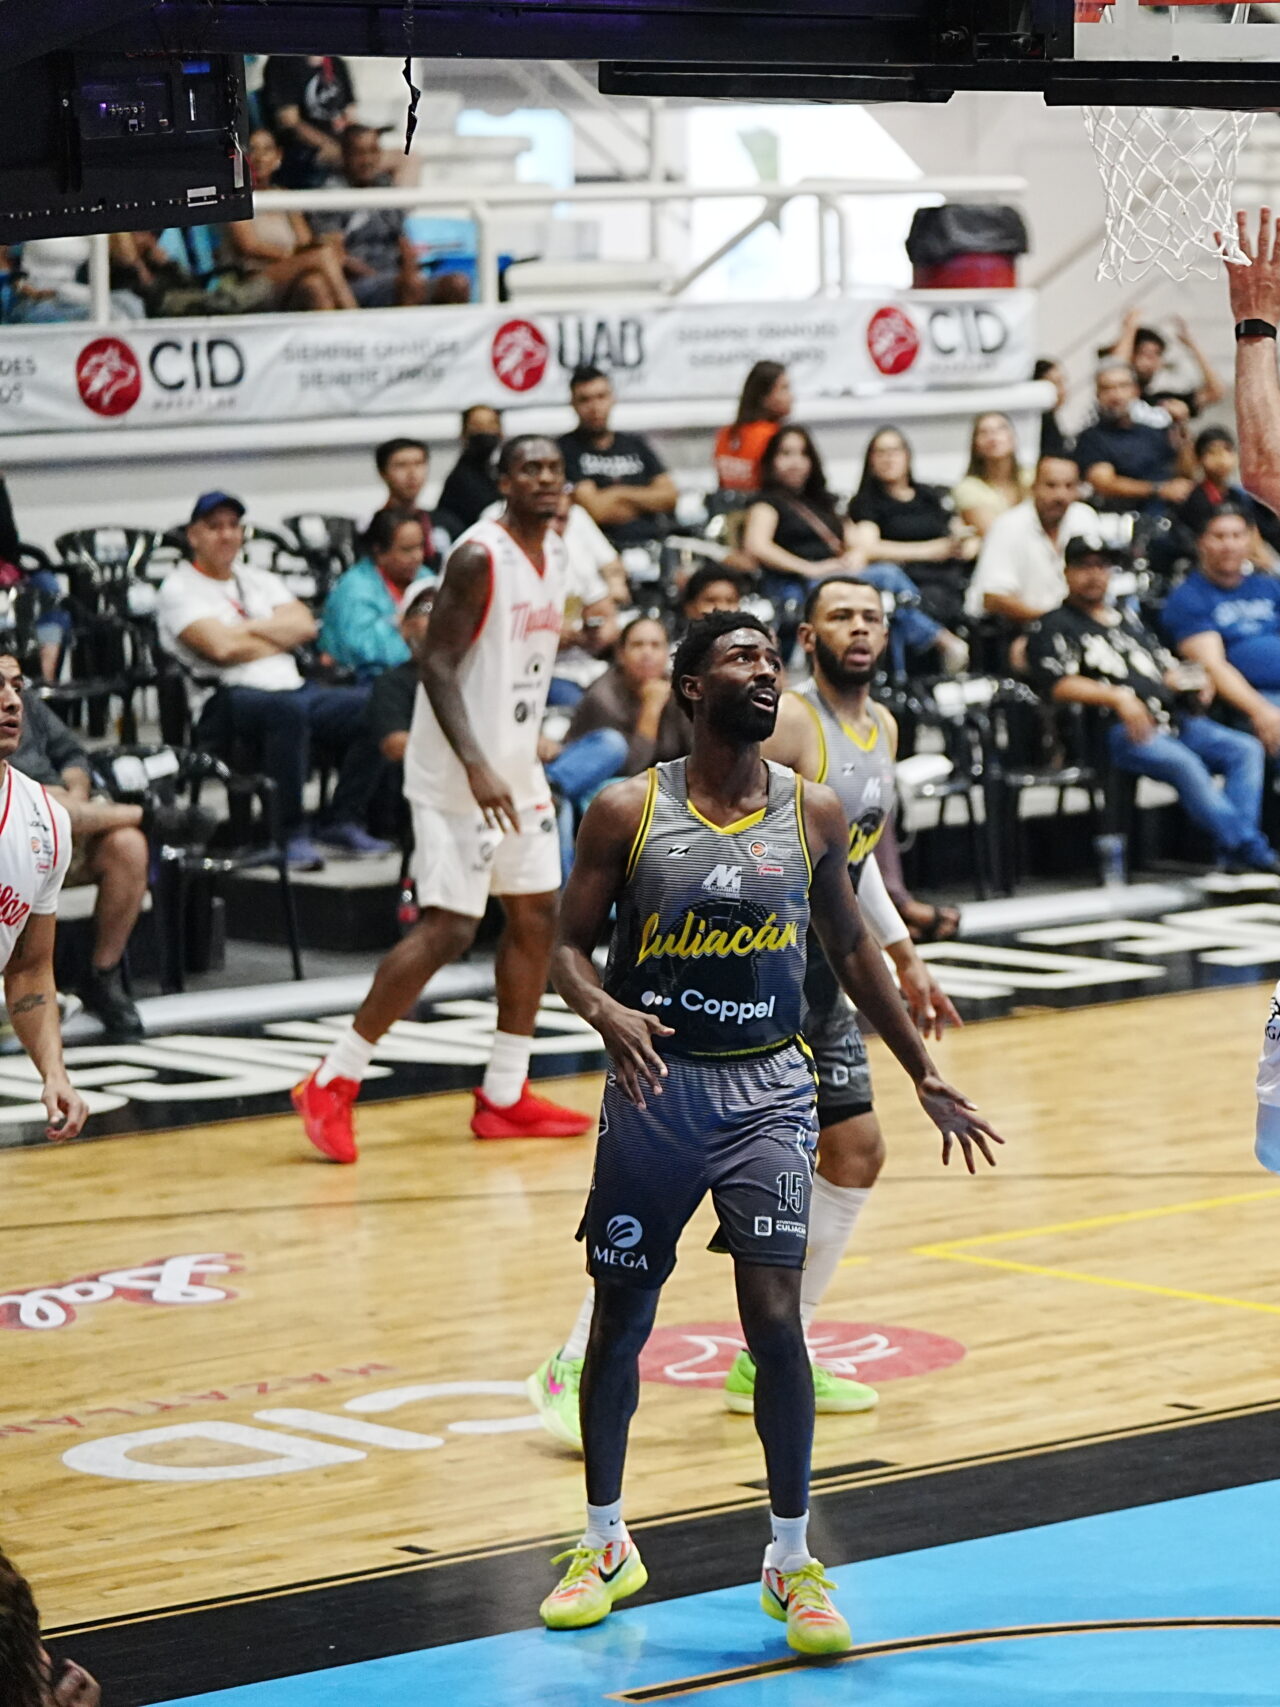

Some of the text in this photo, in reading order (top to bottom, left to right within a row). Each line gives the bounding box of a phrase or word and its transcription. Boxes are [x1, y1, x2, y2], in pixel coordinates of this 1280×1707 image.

[929, 307, 1009, 354] CID
[149, 338, 246, 391] CID
[680, 989, 776, 1024] Coppel
[776, 1171, 805, 1214] 15
[593, 1245, 649, 1270] MEGA
